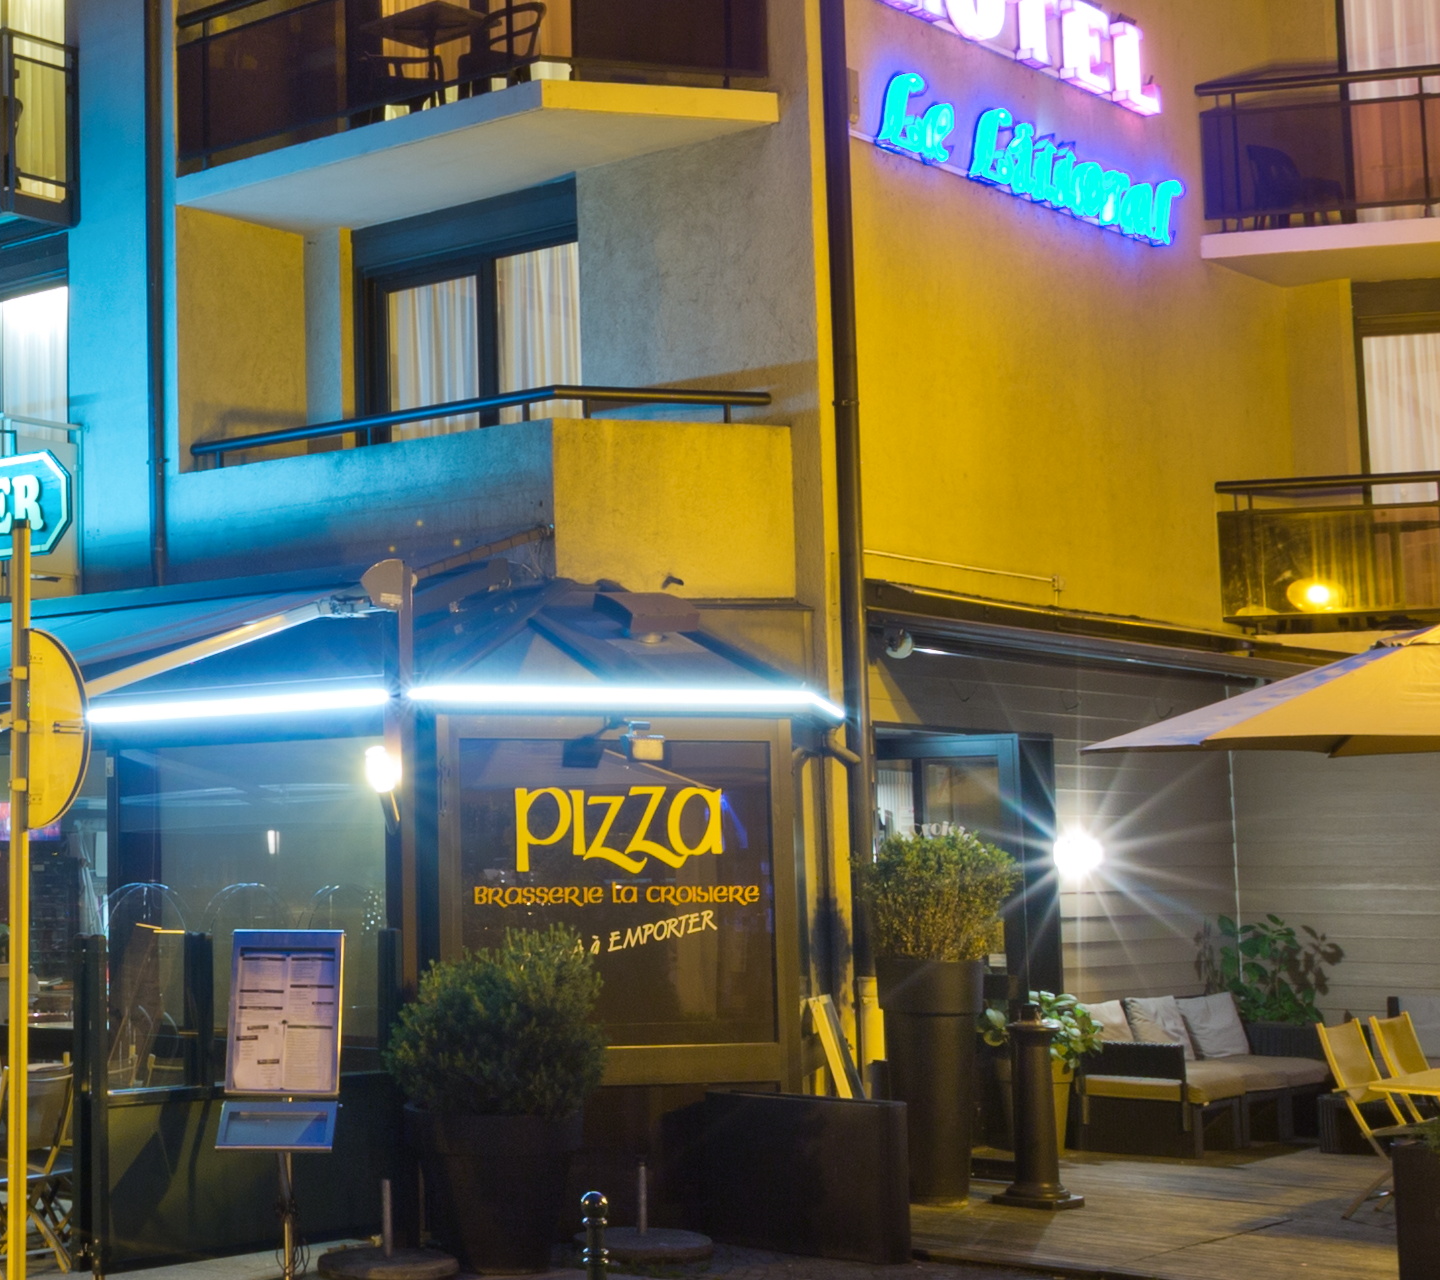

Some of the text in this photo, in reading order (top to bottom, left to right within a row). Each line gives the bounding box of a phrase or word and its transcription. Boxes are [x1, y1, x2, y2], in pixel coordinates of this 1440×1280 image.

[875, 72, 1187, 247] Le Littoral
[607, 909, 719, 954] EMPORTER
